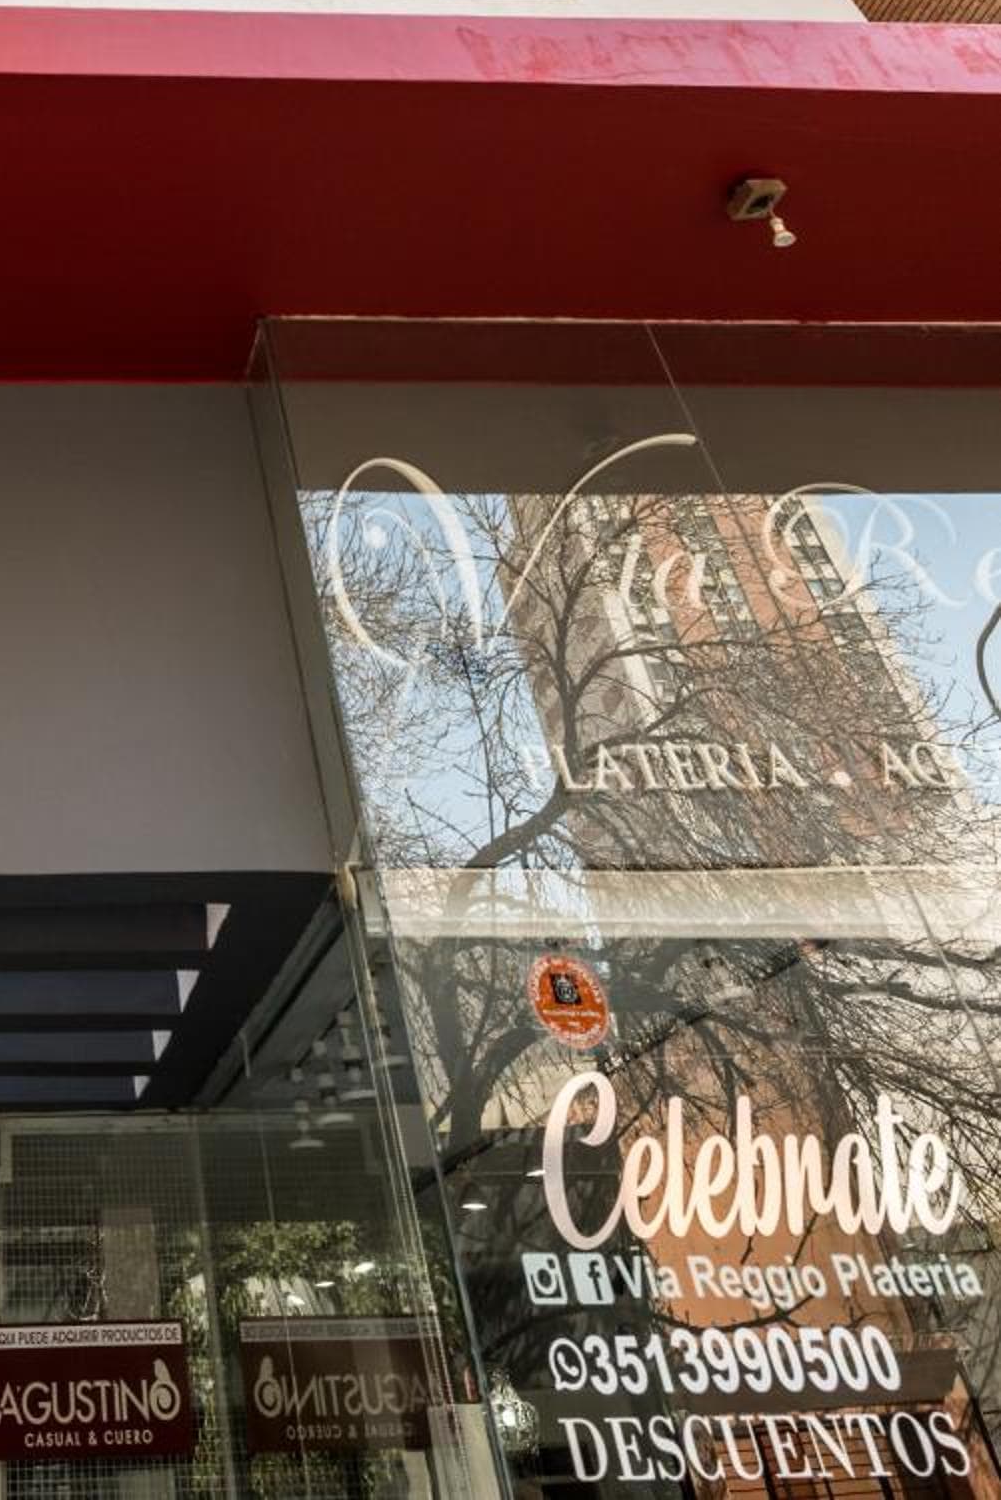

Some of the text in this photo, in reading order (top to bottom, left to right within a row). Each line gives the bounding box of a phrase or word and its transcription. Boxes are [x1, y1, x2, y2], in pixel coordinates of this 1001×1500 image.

[542, 1070, 962, 1251] Celebrate
[612, 1255, 682, 1299] Via
[687, 1255, 829, 1309] Reggio
[831, 1254, 984, 1299] Plateria
[18, 1331, 48, 1346] PUEDE
[52, 1329, 99, 1345] ADQUIRIR
[101, 1327, 163, 1343] PRODUCTOS
[165, 1326, 181, 1342] DE
[584, 1325, 901, 1396] 3513990500
[24, 1429, 154, 1448] CASUAL & CUERO
[557, 1411, 972, 1482] DESCUENTOS
